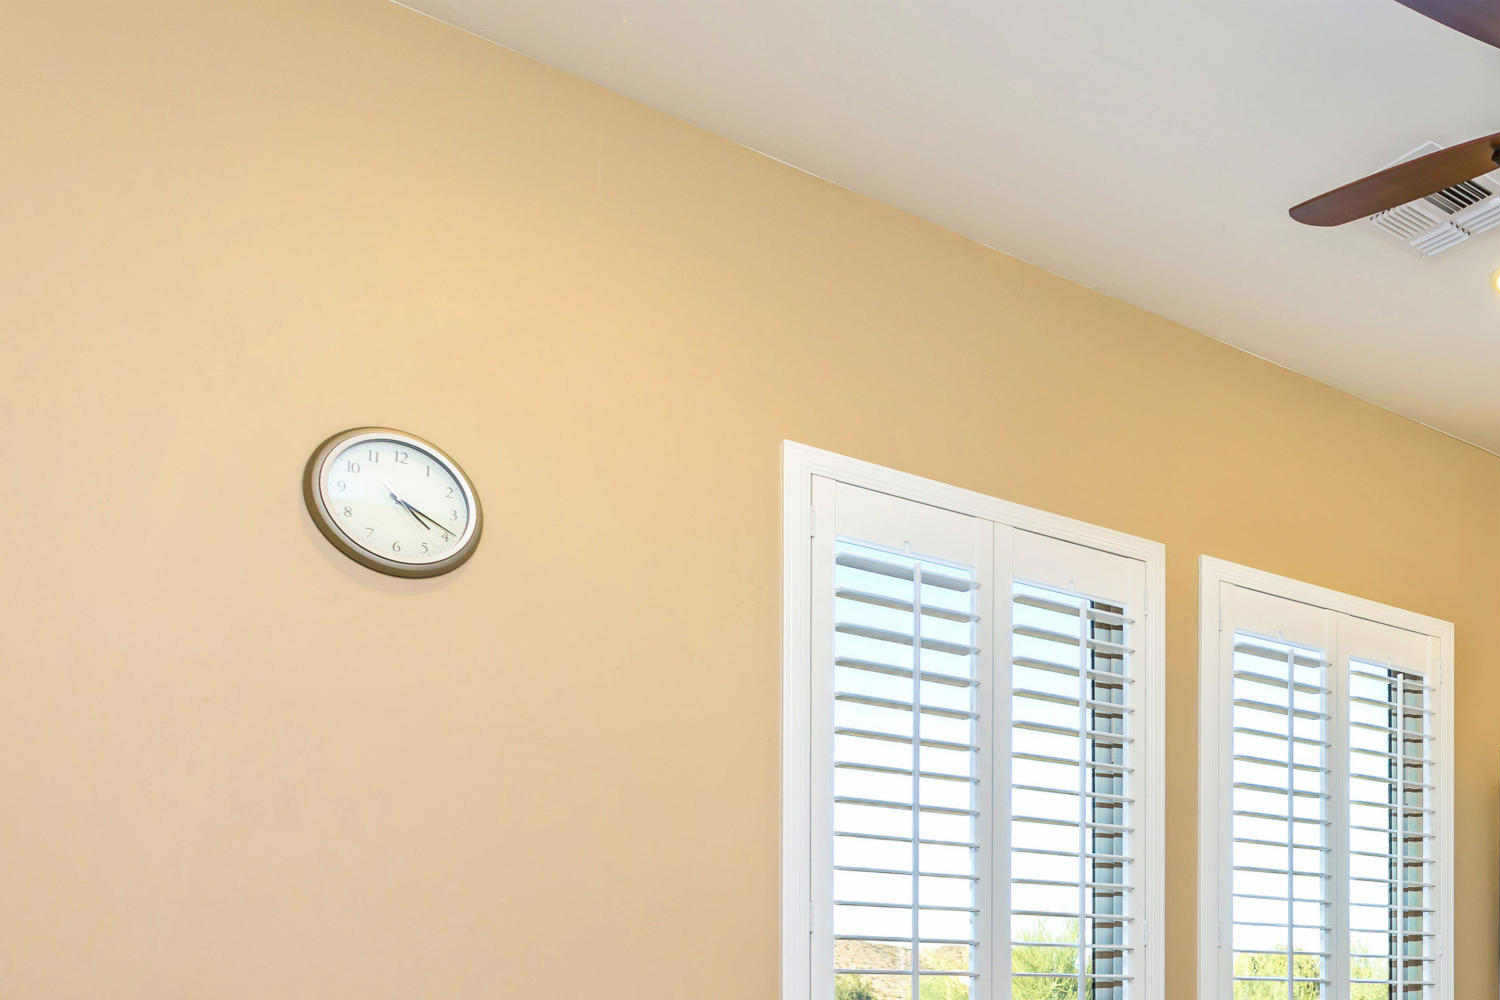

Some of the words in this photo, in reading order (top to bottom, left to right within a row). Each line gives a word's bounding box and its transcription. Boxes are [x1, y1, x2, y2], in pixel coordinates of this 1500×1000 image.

[368, 450, 380, 463] 11
[394, 450, 408, 464] 12
[346, 460, 361, 474] 10
[425, 466, 430, 477] 1
[336, 482, 346, 492] 9
[445, 487, 455, 498] 2
[344, 506, 352, 518] 8
[448, 510, 458, 522] 3
[365, 526, 375, 539] 7
[440, 532, 450, 543] 4
[392, 541, 401, 553] 6
[420, 542, 429, 554] 5
